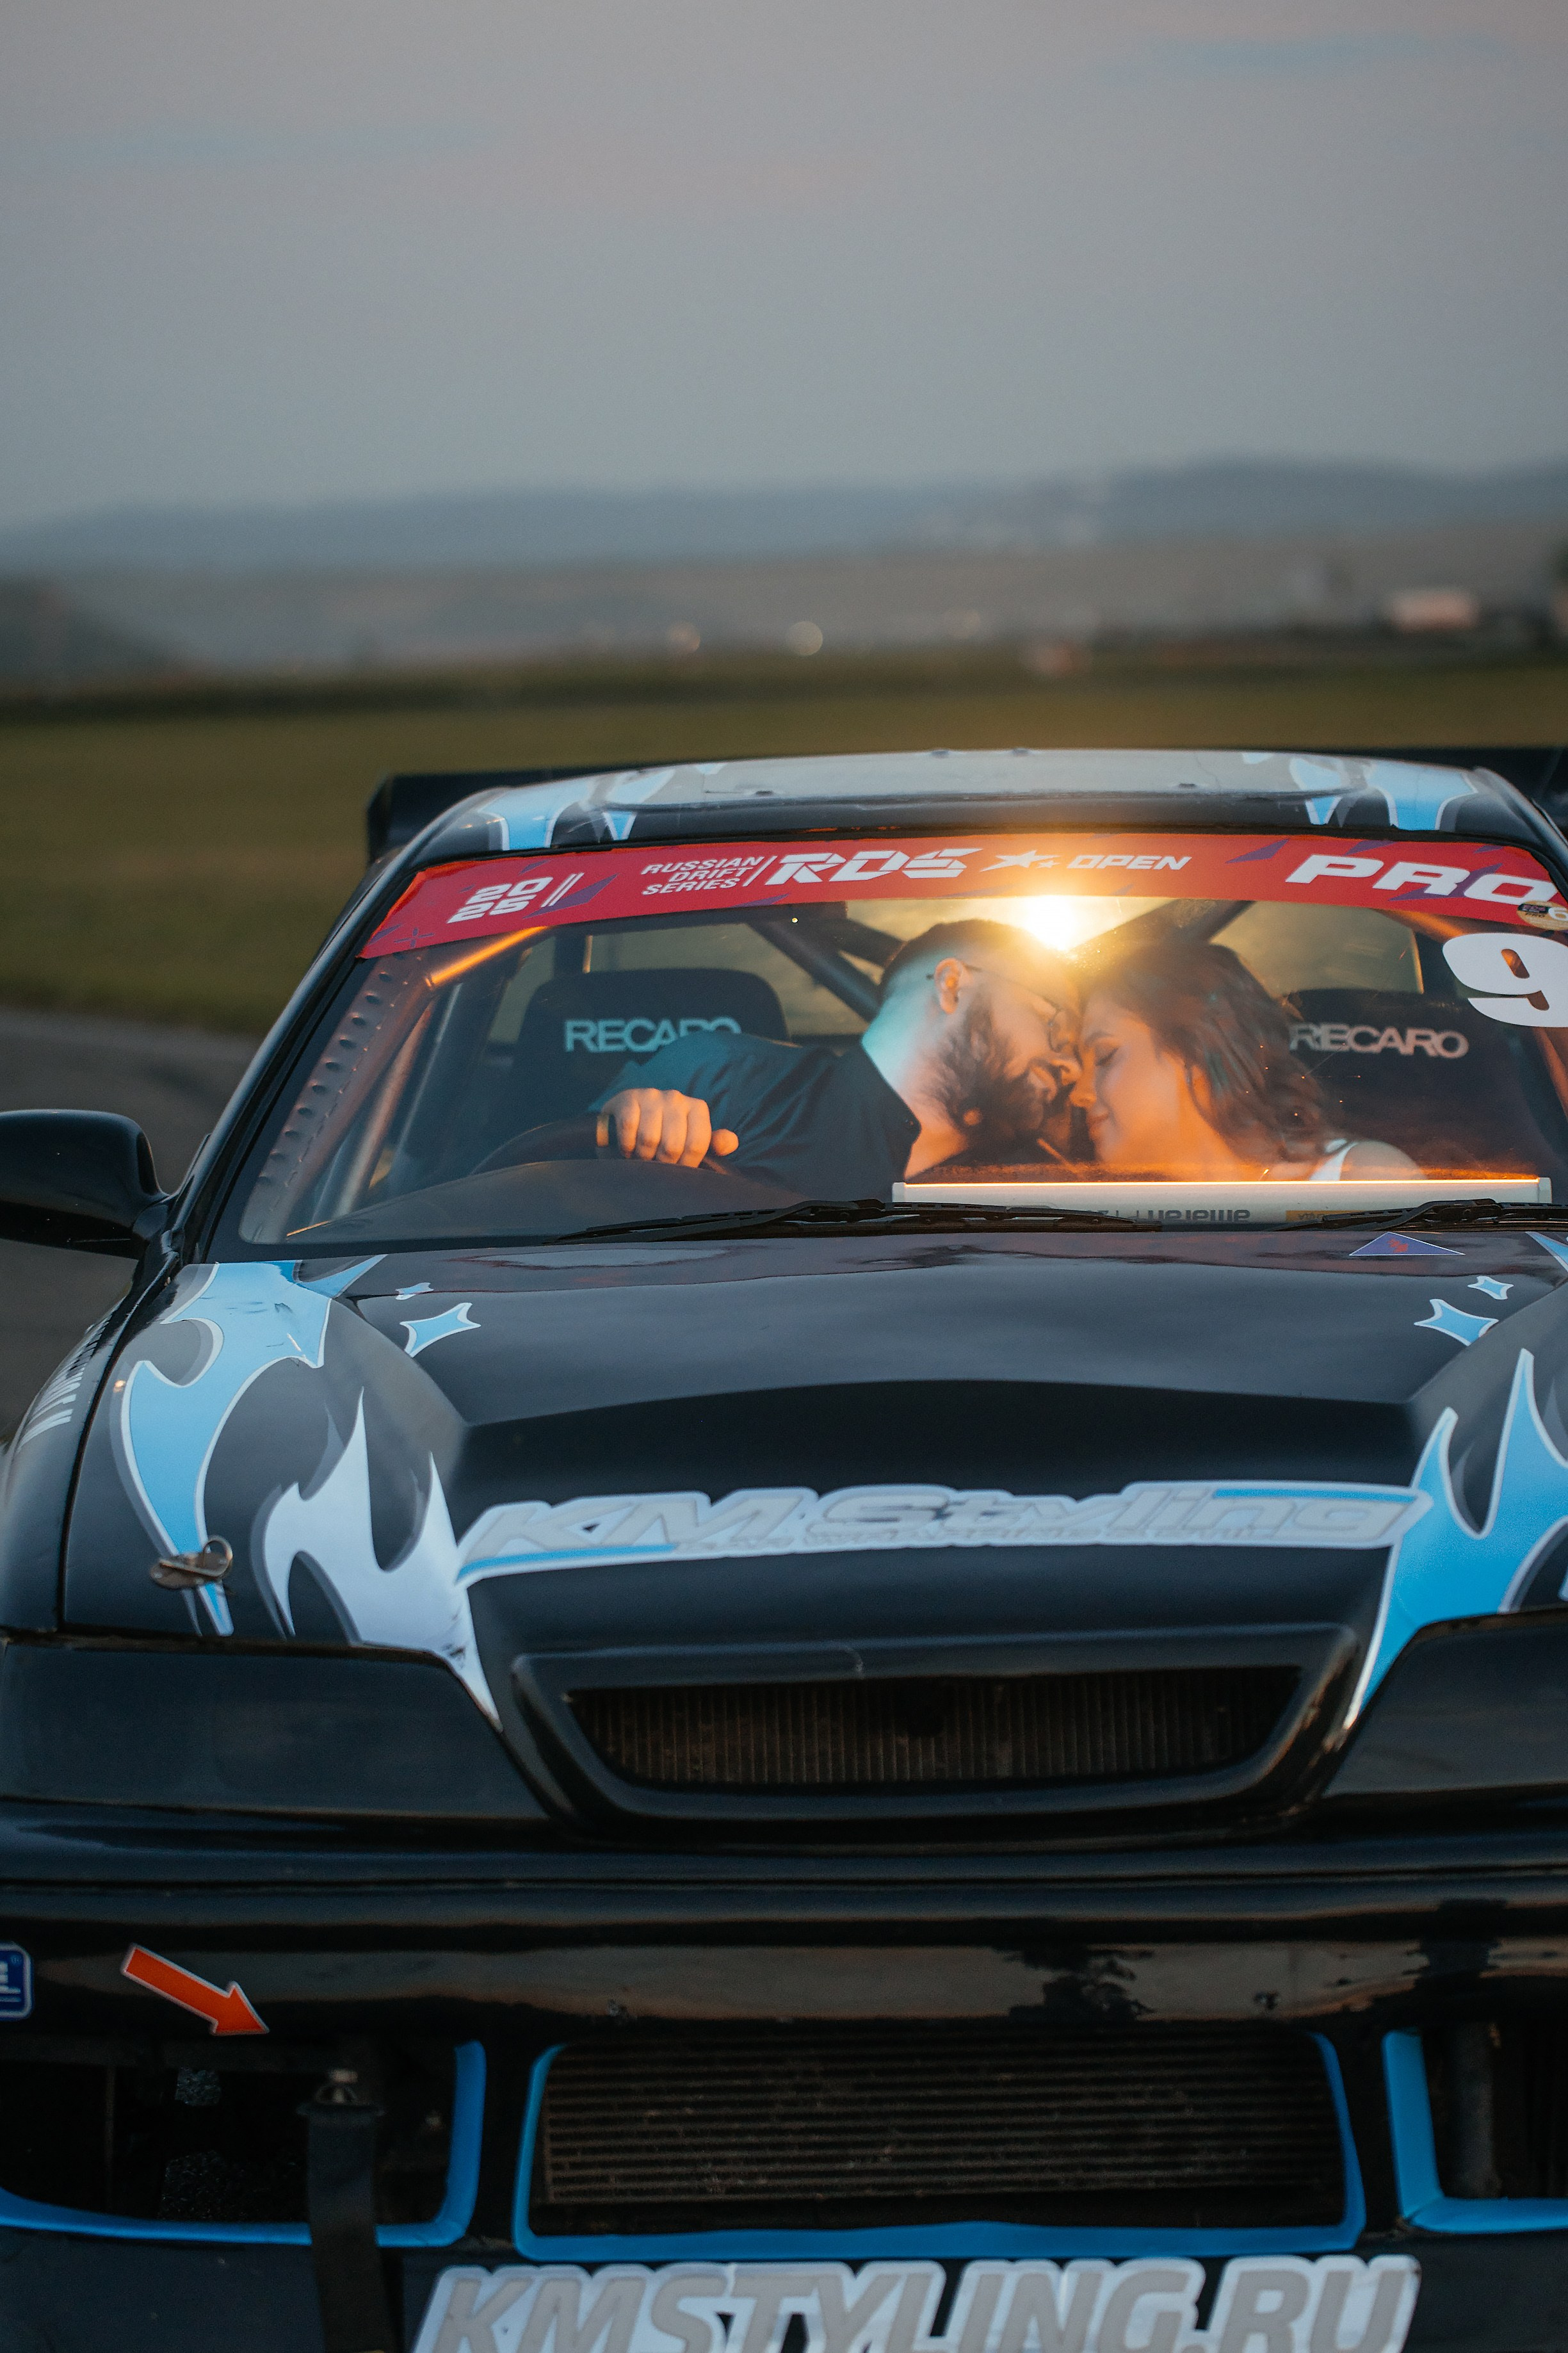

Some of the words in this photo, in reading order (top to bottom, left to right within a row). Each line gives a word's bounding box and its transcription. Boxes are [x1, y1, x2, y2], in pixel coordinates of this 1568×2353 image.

[641, 856, 764, 875] RUSSIAN
[669, 867, 753, 883] DRIFT
[764, 848, 984, 886] RDS
[1066, 854, 1192, 870] OPEN
[465, 877, 553, 905] 20
[641, 878, 749, 896] SERIES
[1285, 854, 1558, 906] PRO
[448, 896, 537, 924] 25
[1442, 932, 1568, 1027] 9
[1289, 1022, 1469, 1059] RECARO
